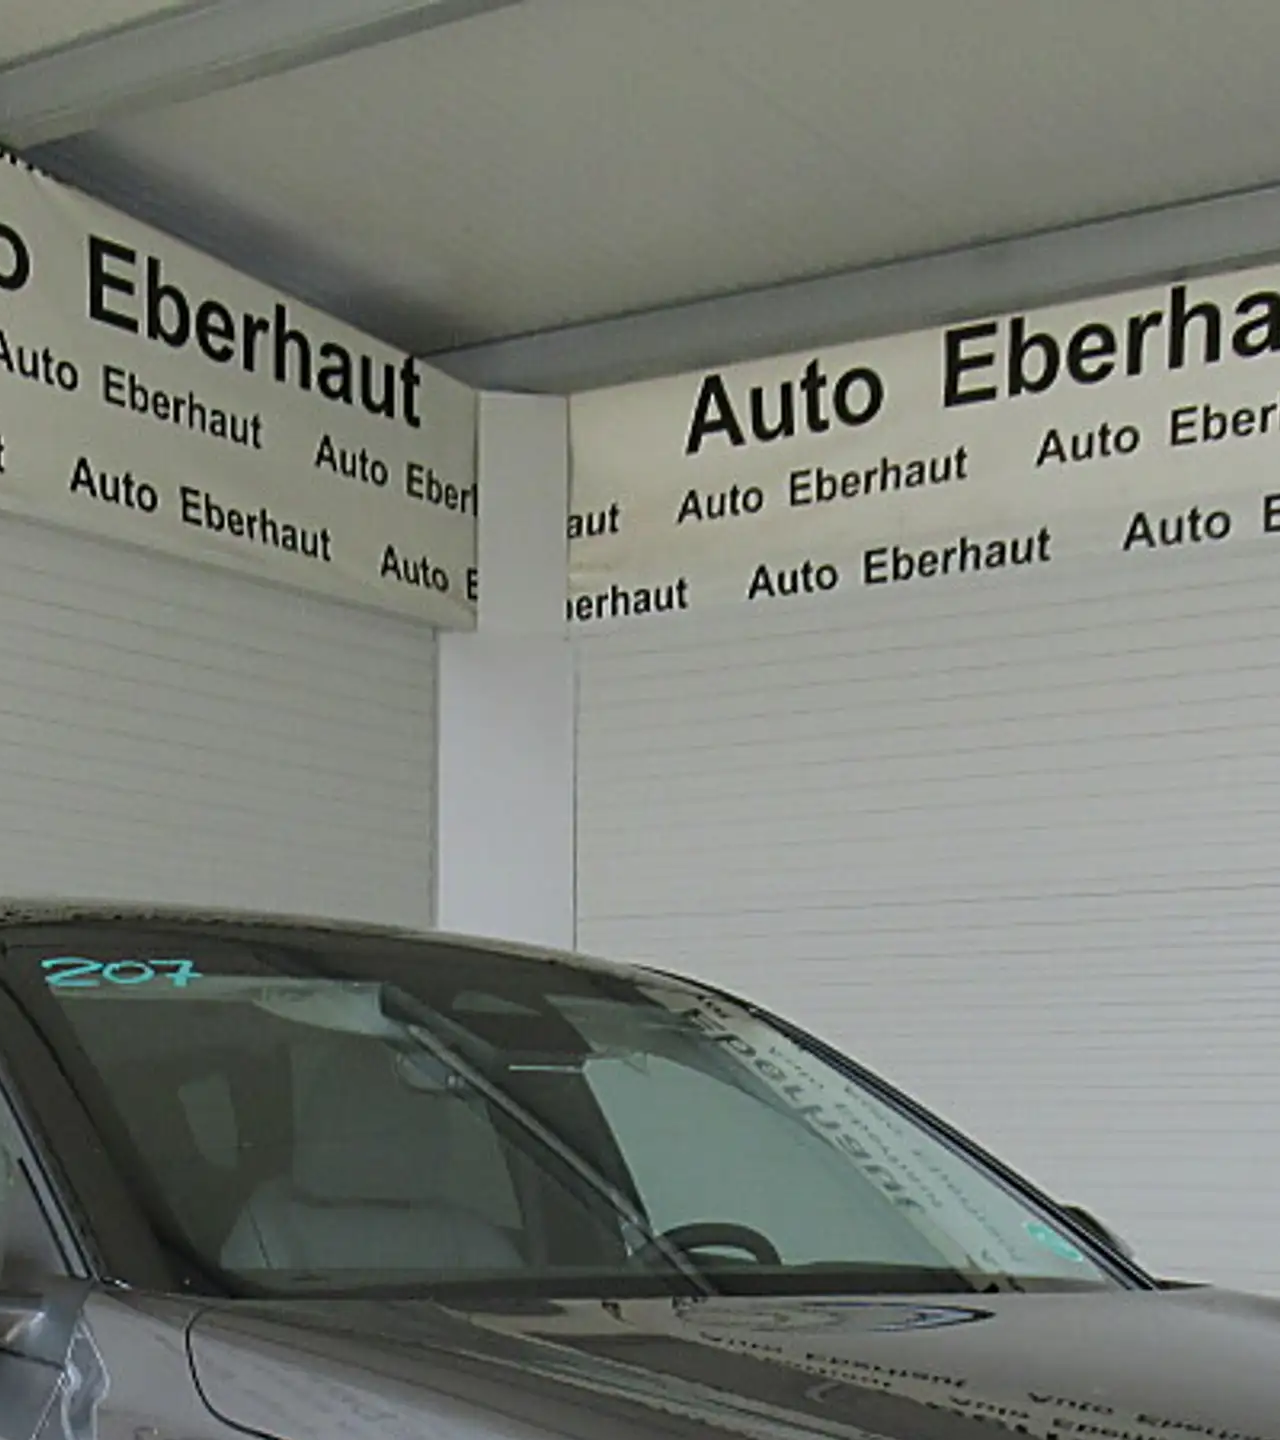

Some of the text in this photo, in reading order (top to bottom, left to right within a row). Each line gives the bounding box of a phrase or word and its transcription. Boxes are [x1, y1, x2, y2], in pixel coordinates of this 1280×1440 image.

[88, 234, 422, 429] Eberhaut
[102, 364, 263, 450] Eberhaut
[684, 357, 884, 455] Auto
[314, 434, 389, 488] Auto
[1036, 422, 1141, 468] Auto
[69, 456, 332, 563] Auto Eberhaut
[676, 444, 969, 525] Auto Eberhaut
[747, 526, 1052, 603] Auto Eberhaut
[1122, 505, 1232, 552] Auto
[380, 543, 450, 594] Auto
[40, 957, 203, 988] 207
